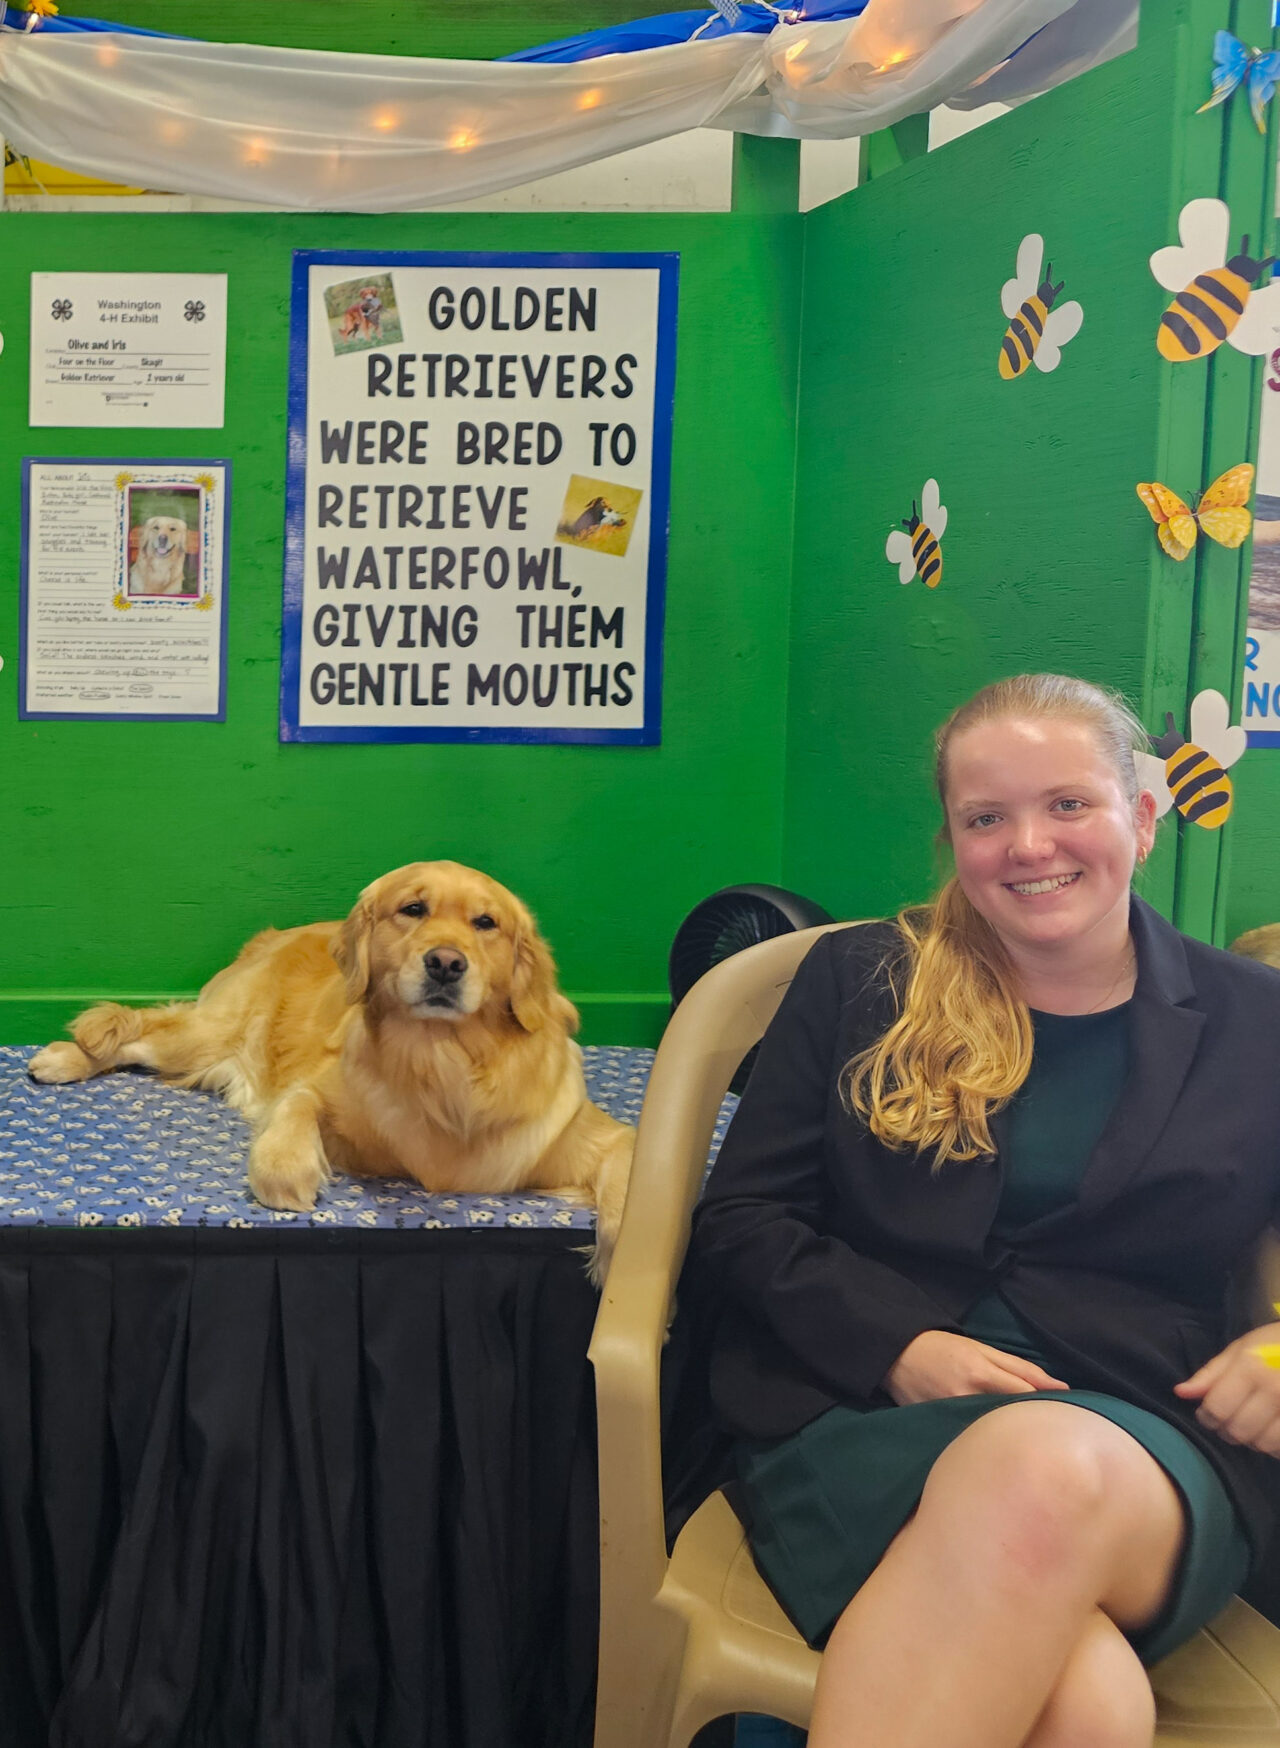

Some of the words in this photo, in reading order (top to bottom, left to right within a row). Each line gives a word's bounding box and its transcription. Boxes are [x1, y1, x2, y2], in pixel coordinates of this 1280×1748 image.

[98, 299, 162, 312] Washington
[99, 313, 118, 324] 4-H
[121, 313, 159, 324] Exhibit
[428, 286, 597, 332] GOLDEN
[67, 339, 89, 350] Olive
[91, 340, 109, 350] and
[112, 339, 126, 350] Iris
[367, 353, 638, 399] RETRIEVERS
[320, 420, 429, 465] WERE
[456, 421, 563, 466] BRED
[588, 422, 637, 467] TO
[318, 484, 529, 531] RETRIEVE
[317, 546, 582, 599] WATERFOWL,
[313, 603, 478, 649] GIVING
[515, 604, 625, 649] THEM
[310, 662, 451, 707] GENTLE
[466, 661, 636, 708] MOUTHS
